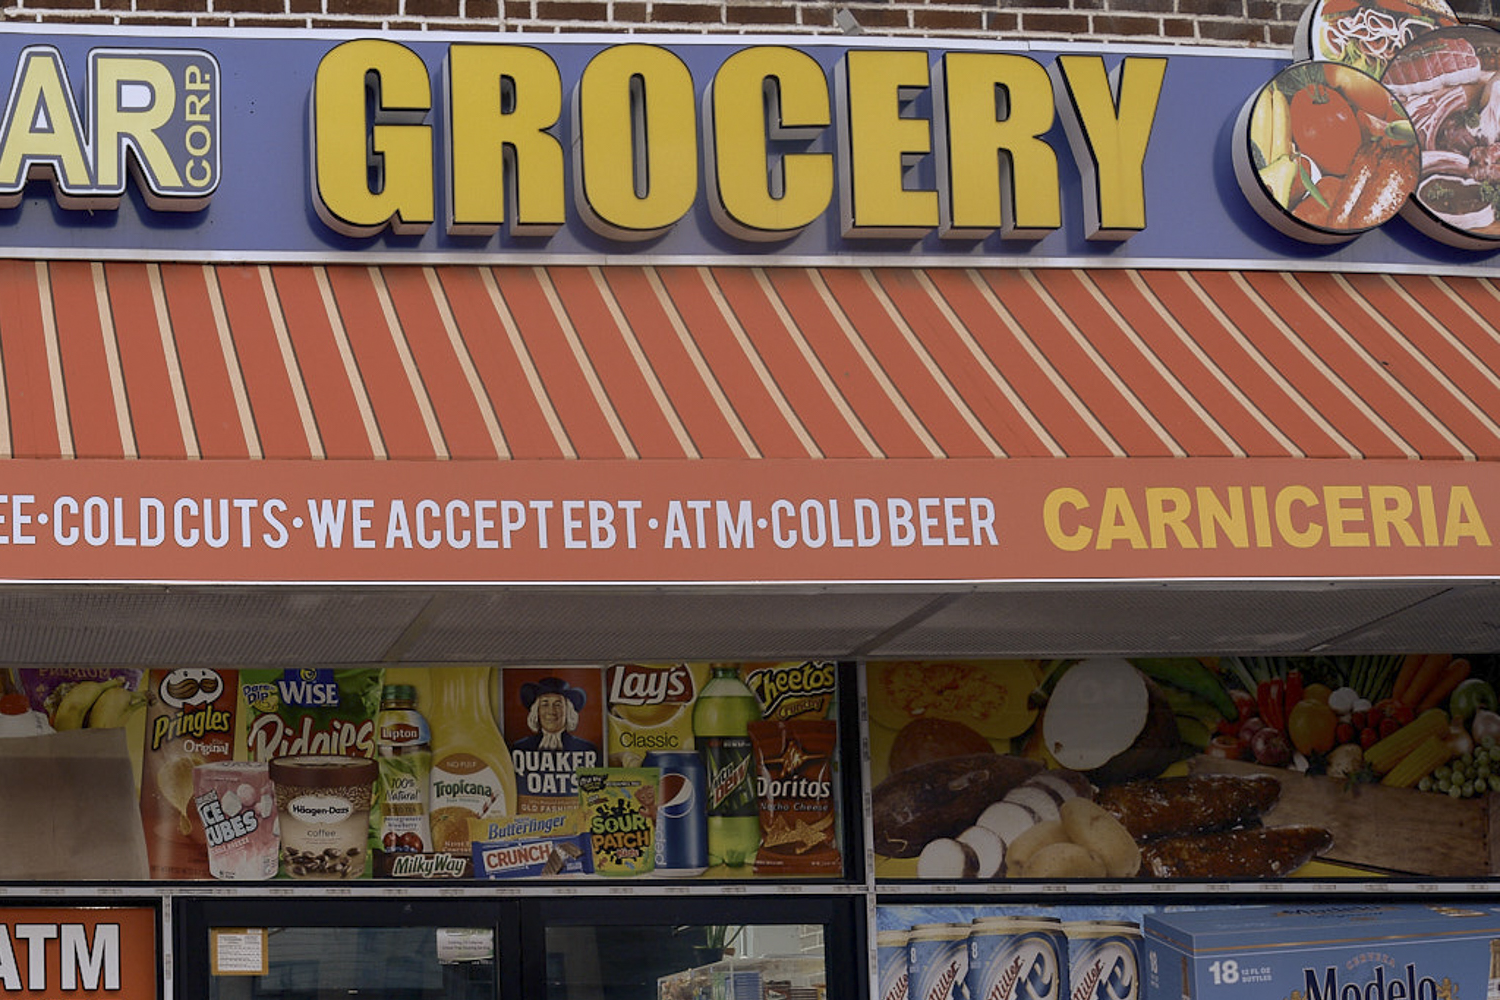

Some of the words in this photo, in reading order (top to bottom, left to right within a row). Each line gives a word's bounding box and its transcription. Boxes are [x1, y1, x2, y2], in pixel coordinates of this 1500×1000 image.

[184, 64, 213, 188] CORP.
[312, 38, 1168, 234] GROCERY
[53, 496, 165, 547] COLD
[308, 499, 375, 549] WE
[385, 499, 555, 549] ACCEPT
[563, 499, 639, 549] EBT
[665, 499, 754, 549] ATM
[771, 498, 879, 548] COLD
[889, 497, 998, 547] BEER
[1043, 485, 1491, 551] CARNICERIA
[279, 680, 339, 704] WISE
[610, 665, 688, 705] Lay's
[747, 662, 835, 714] Cheetos
[152, 705, 231, 750] Pringles
[383, 729, 417, 740] Lipton
[184, 739, 230, 755] Original
[619, 732, 678, 748] Classic
[512, 750, 596, 776] QUAKER
[434, 779, 492, 798] Tropicana
[757, 775, 831, 798] Doritos
[488, 815, 567, 840] Butterfinger
[592, 814, 647, 834] SOUR
[592, 830, 650, 850] PATCH
[486, 843, 551, 869] CRUNCH
[972, 942, 978, 960] 8
[1208, 960, 1239, 984] 18
